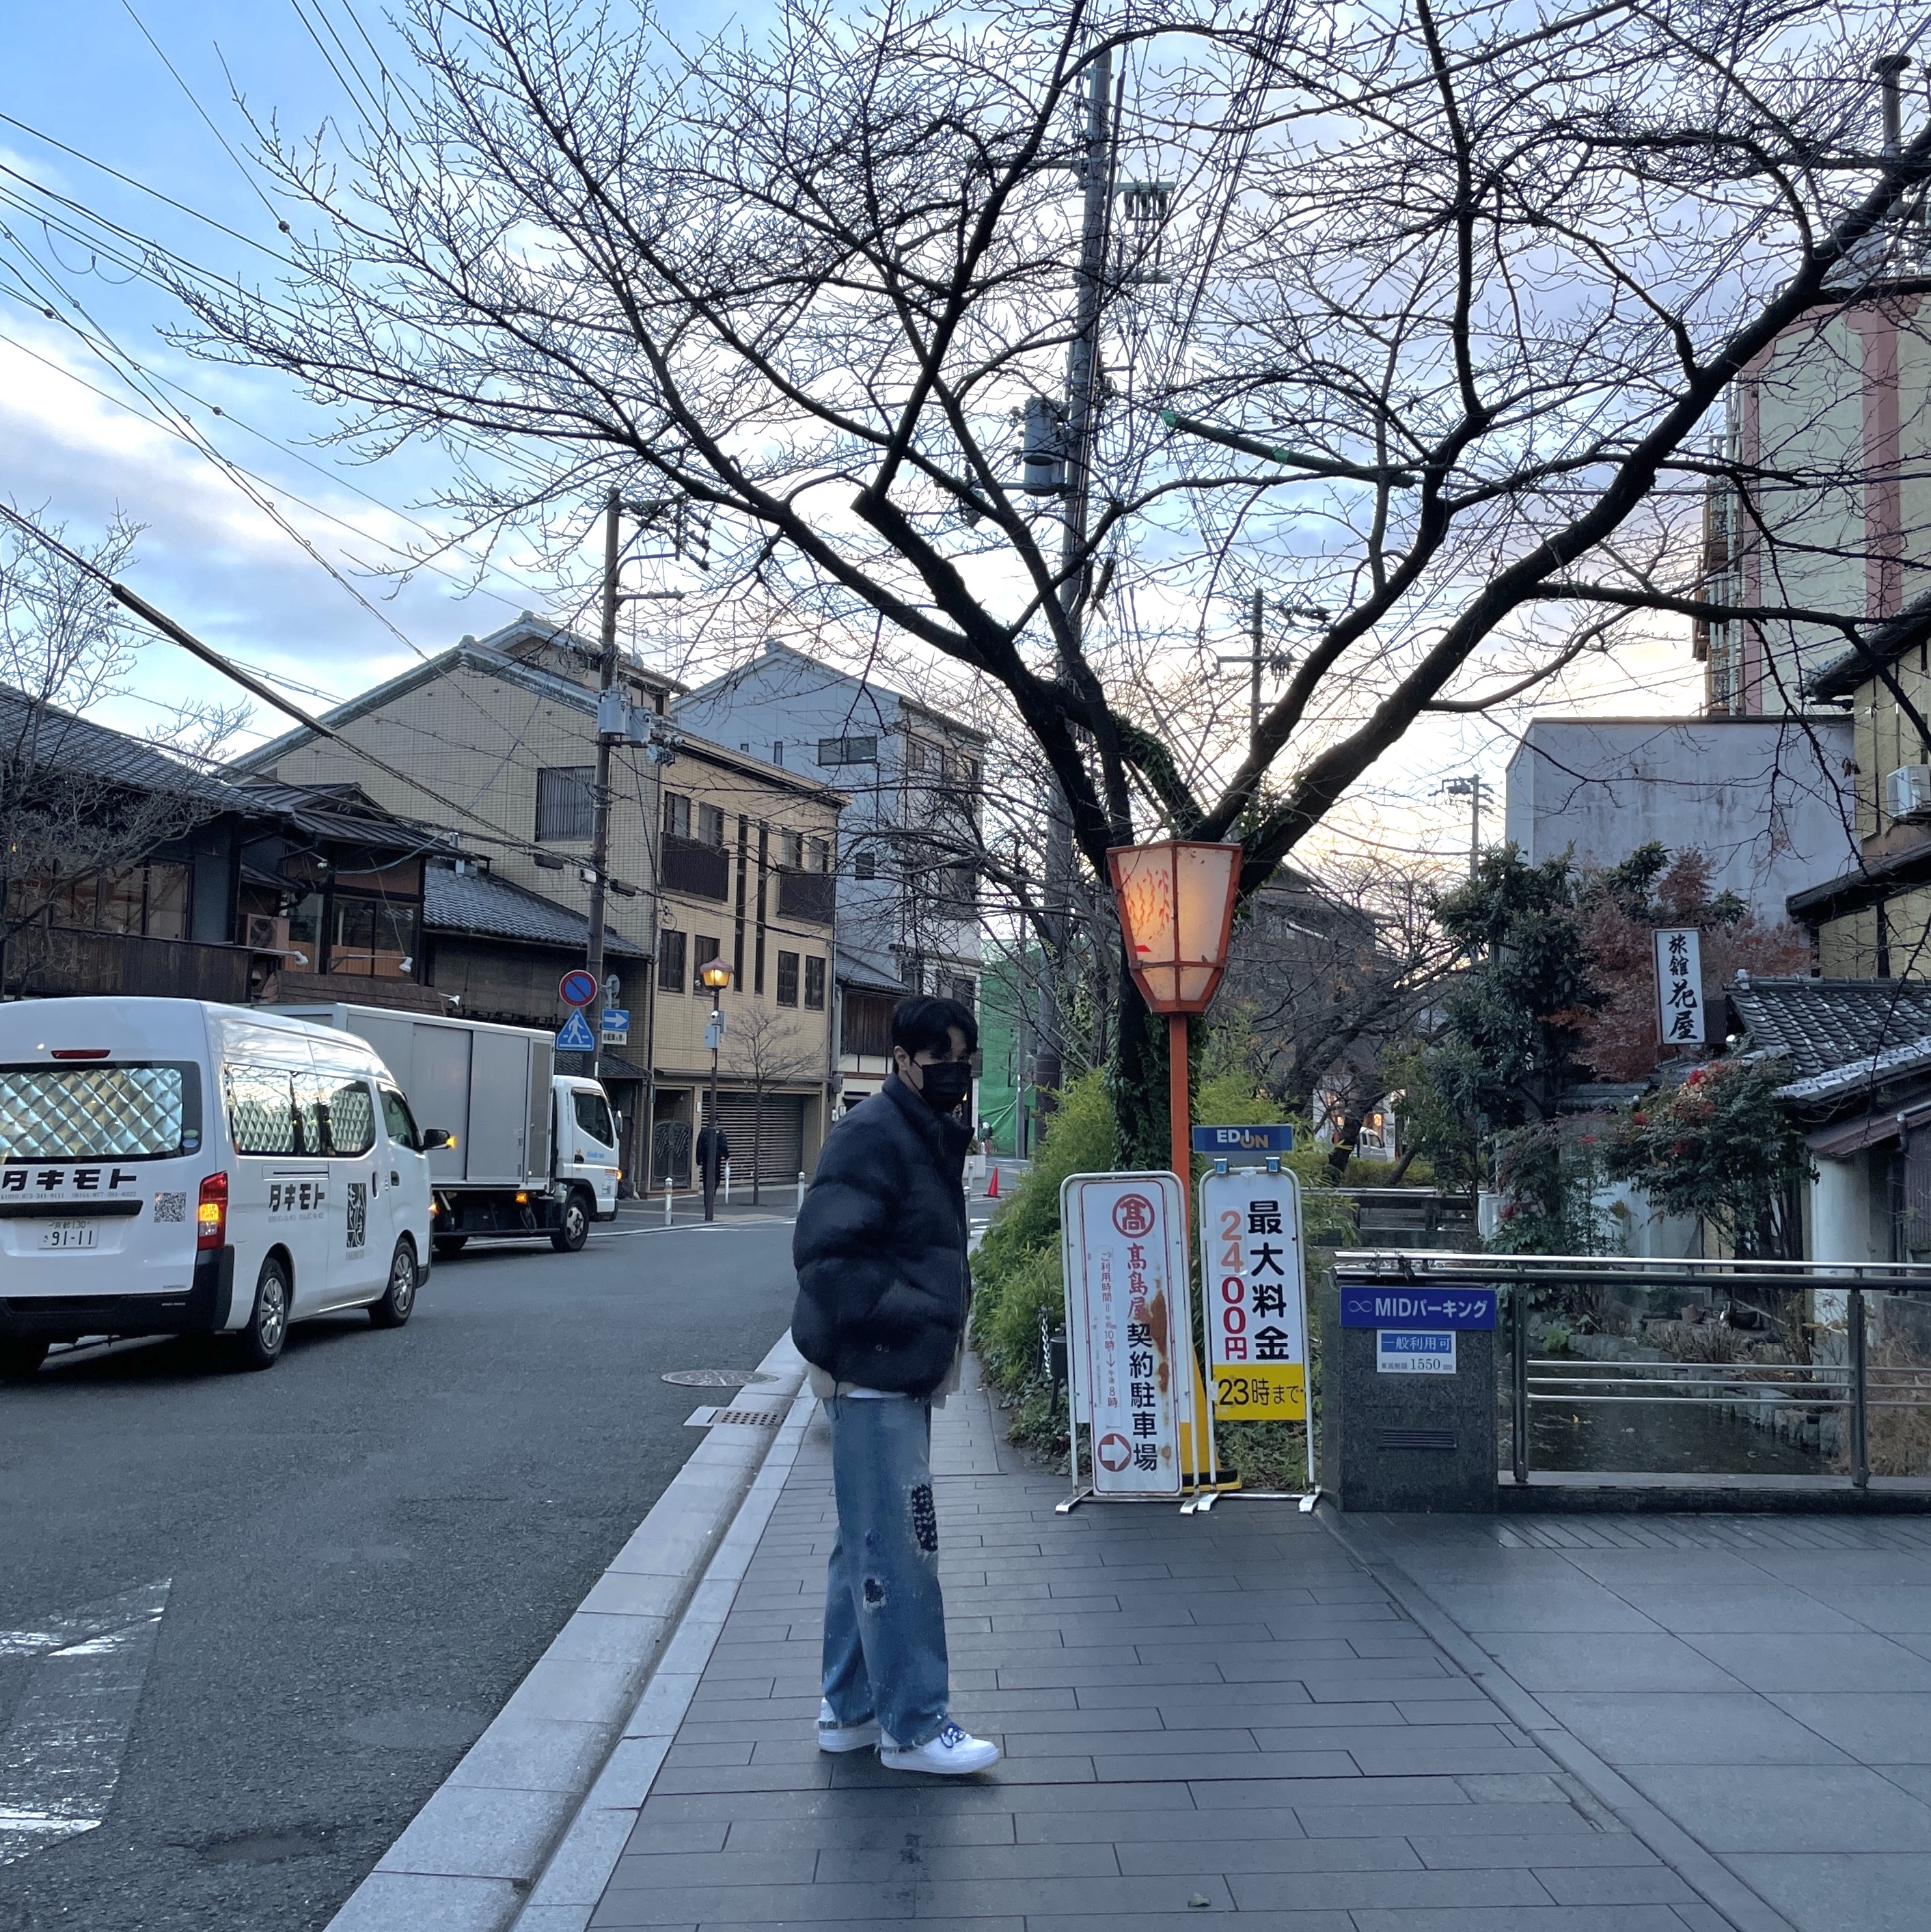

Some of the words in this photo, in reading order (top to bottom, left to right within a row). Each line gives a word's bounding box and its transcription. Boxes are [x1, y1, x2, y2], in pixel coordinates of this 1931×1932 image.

[1216, 1129, 1269, 1149] EDION
[2, 1168, 137, 1191] タキモト
[269, 1183, 325, 1212] タキモト
[51, 1230, 92, 1246] 91-11
[1220, 1210, 1248, 1360] 2400円
[1248, 1200, 1289, 1360] 最大料金
[1375, 1297, 1488, 1319] MIDパーキング
[1382, 1336, 1451, 1351] 一般利用可
[1411, 1358, 1440, 1371] 1550
[1218, 1378, 1301, 1406] 23時まで
